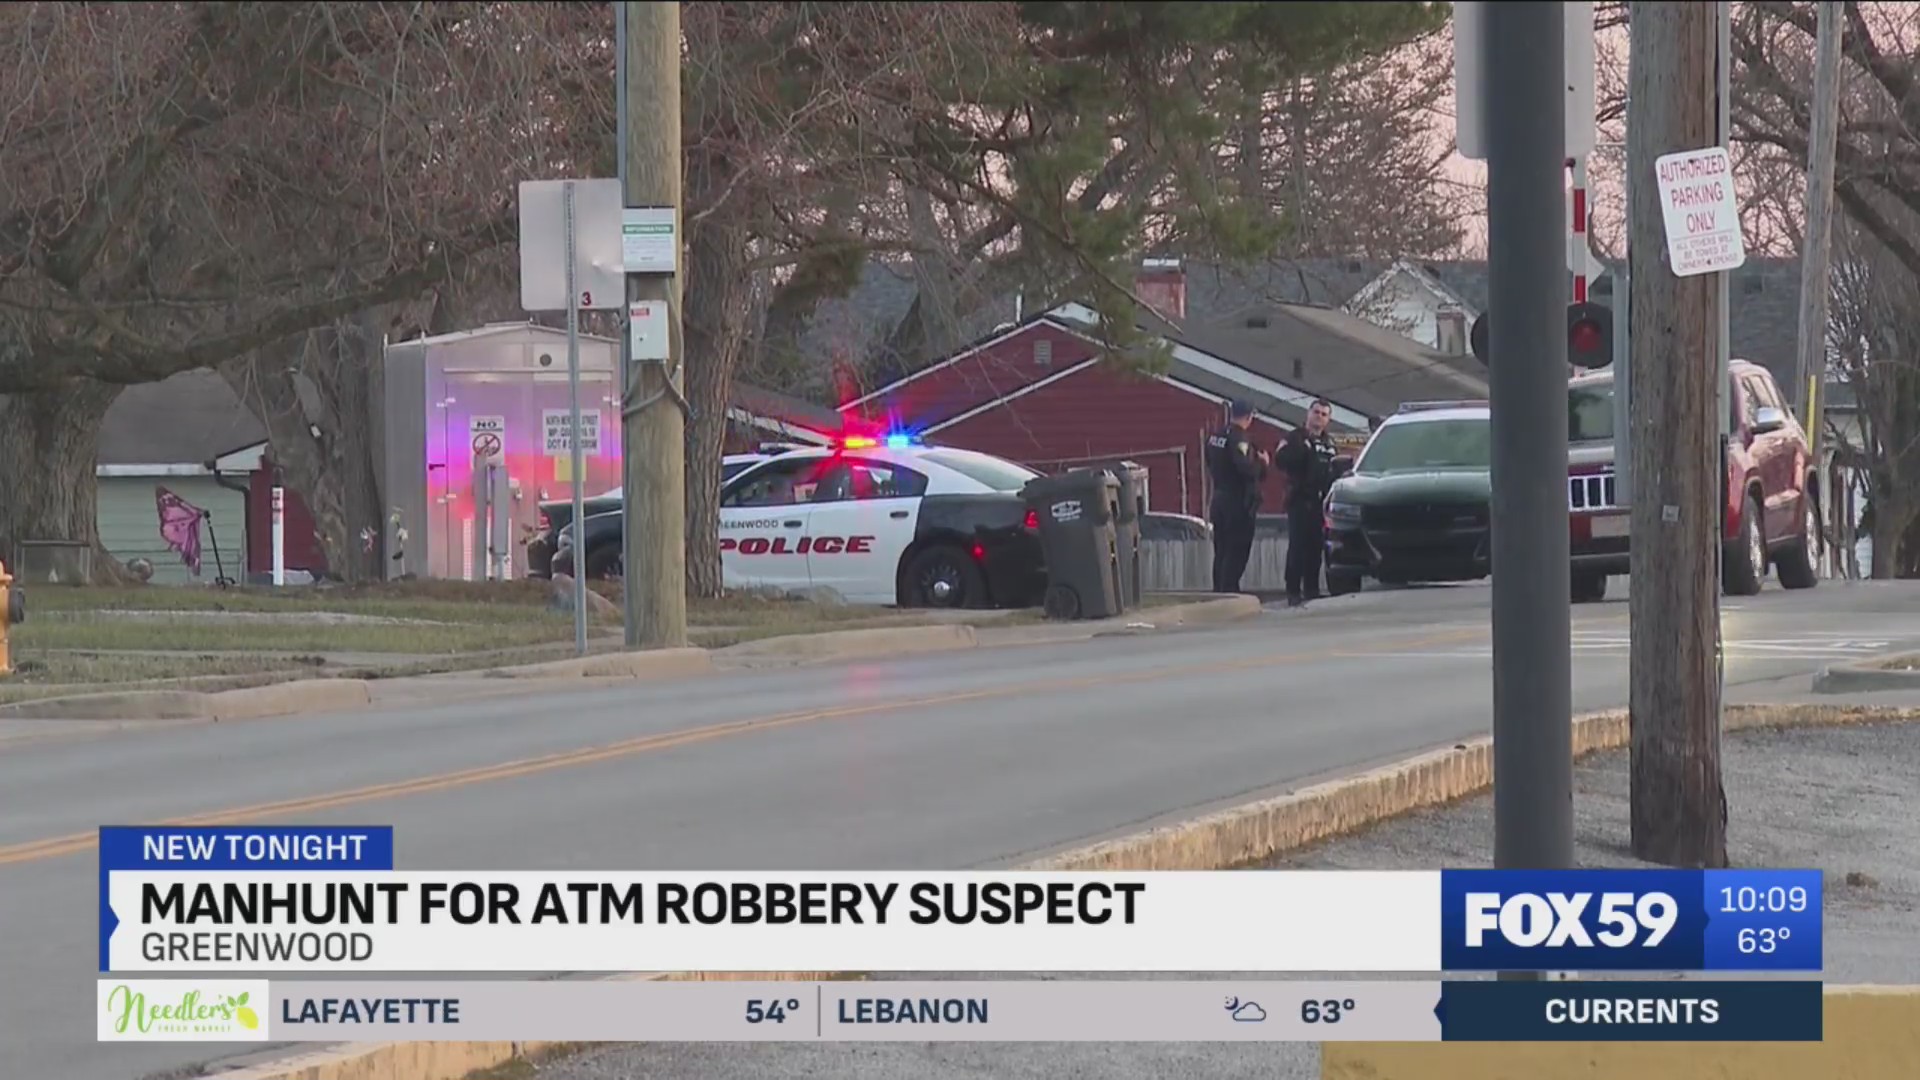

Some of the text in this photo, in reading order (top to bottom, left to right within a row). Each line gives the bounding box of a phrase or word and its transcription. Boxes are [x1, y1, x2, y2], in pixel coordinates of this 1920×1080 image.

[1660, 154, 1726, 183] AUTHORIZED
[1671, 182, 1724, 208] PARKING
[1686, 211, 1716, 233] ONLY
[581, 291, 592, 307] 3
[1209, 436, 1227, 448] POLICE
[719, 536, 875, 554] POLICE
